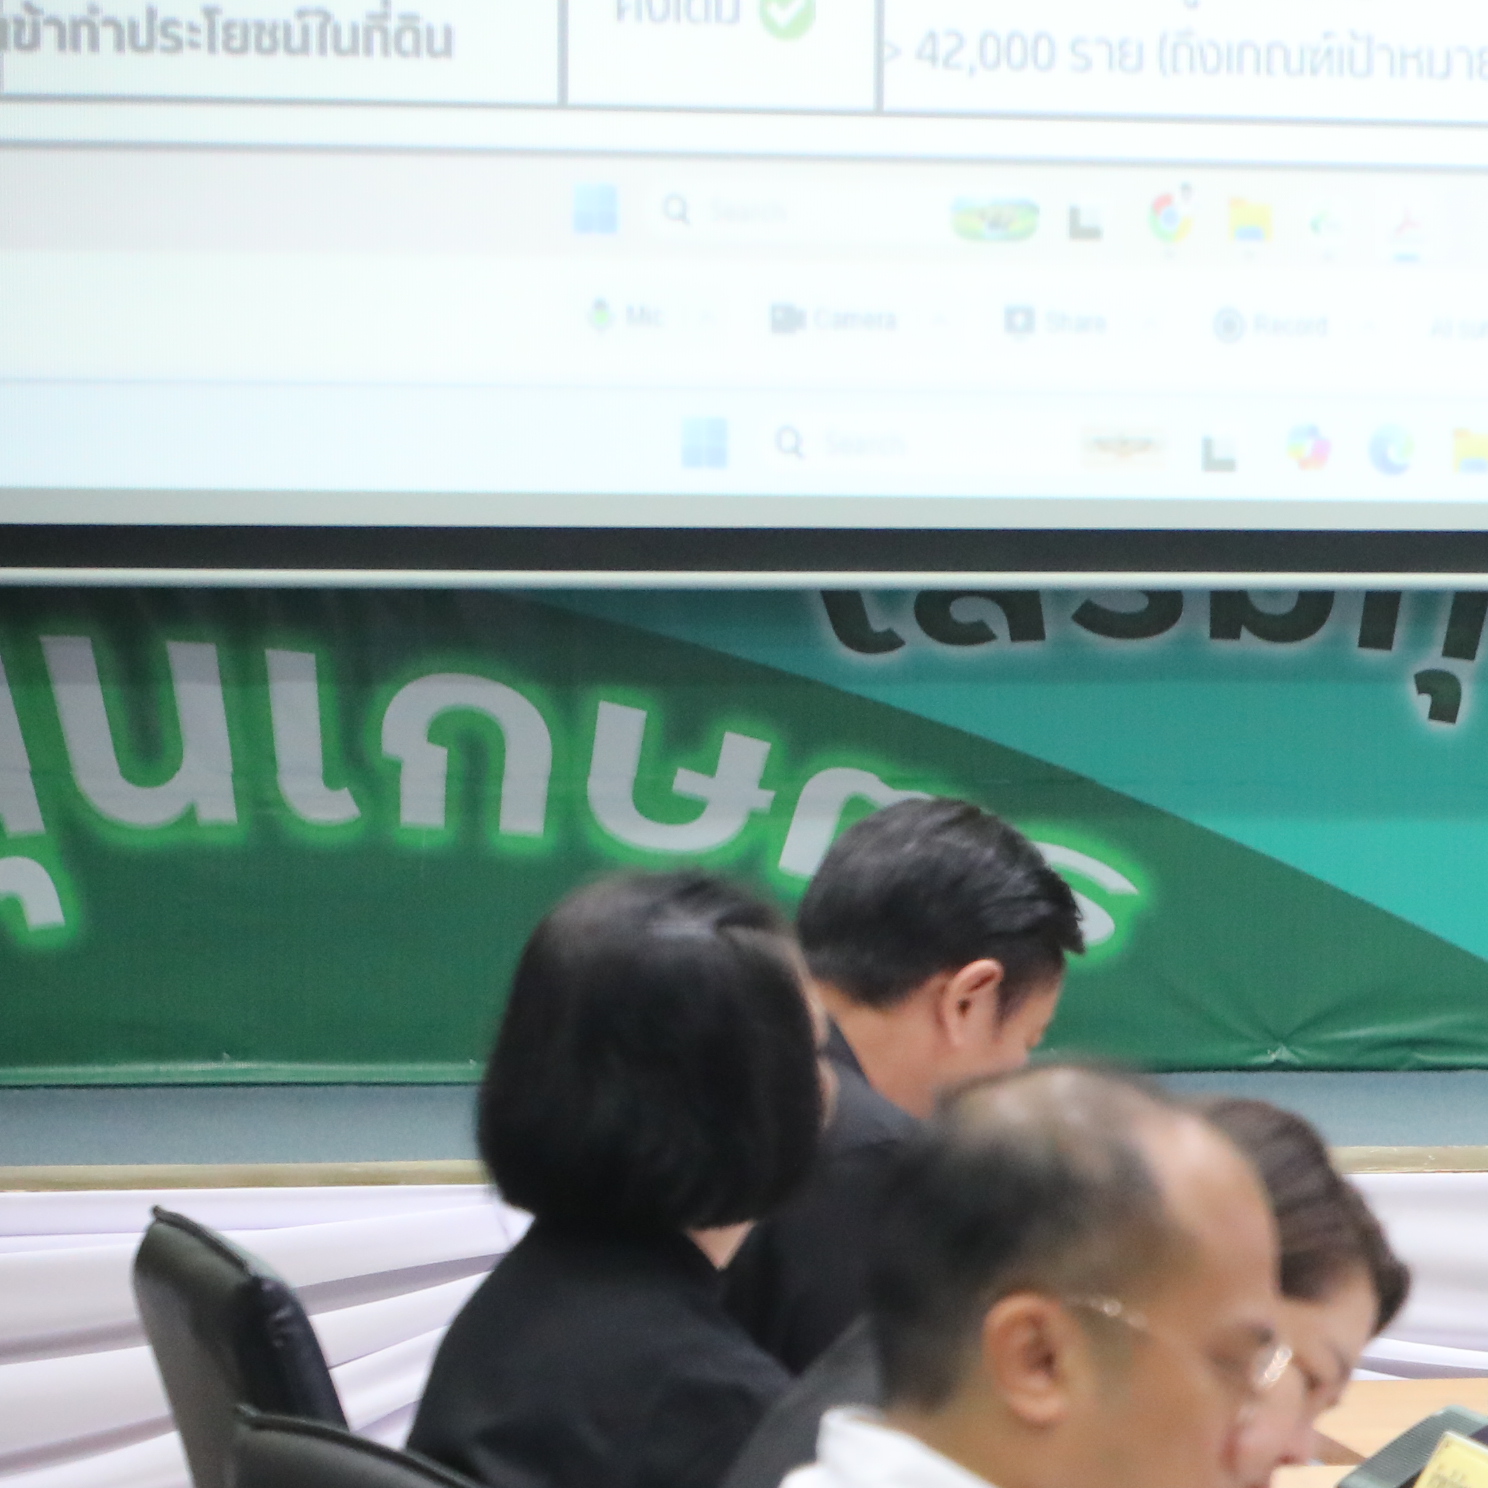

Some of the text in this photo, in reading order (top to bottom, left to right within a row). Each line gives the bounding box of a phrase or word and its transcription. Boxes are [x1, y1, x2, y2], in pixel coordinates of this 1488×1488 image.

[915, 29, 1056, 78] 42,000
[1069, 36, 1144, 74] ราย
[813, 307, 897, 331] Camera
[1253, 313, 1328, 338] Record
